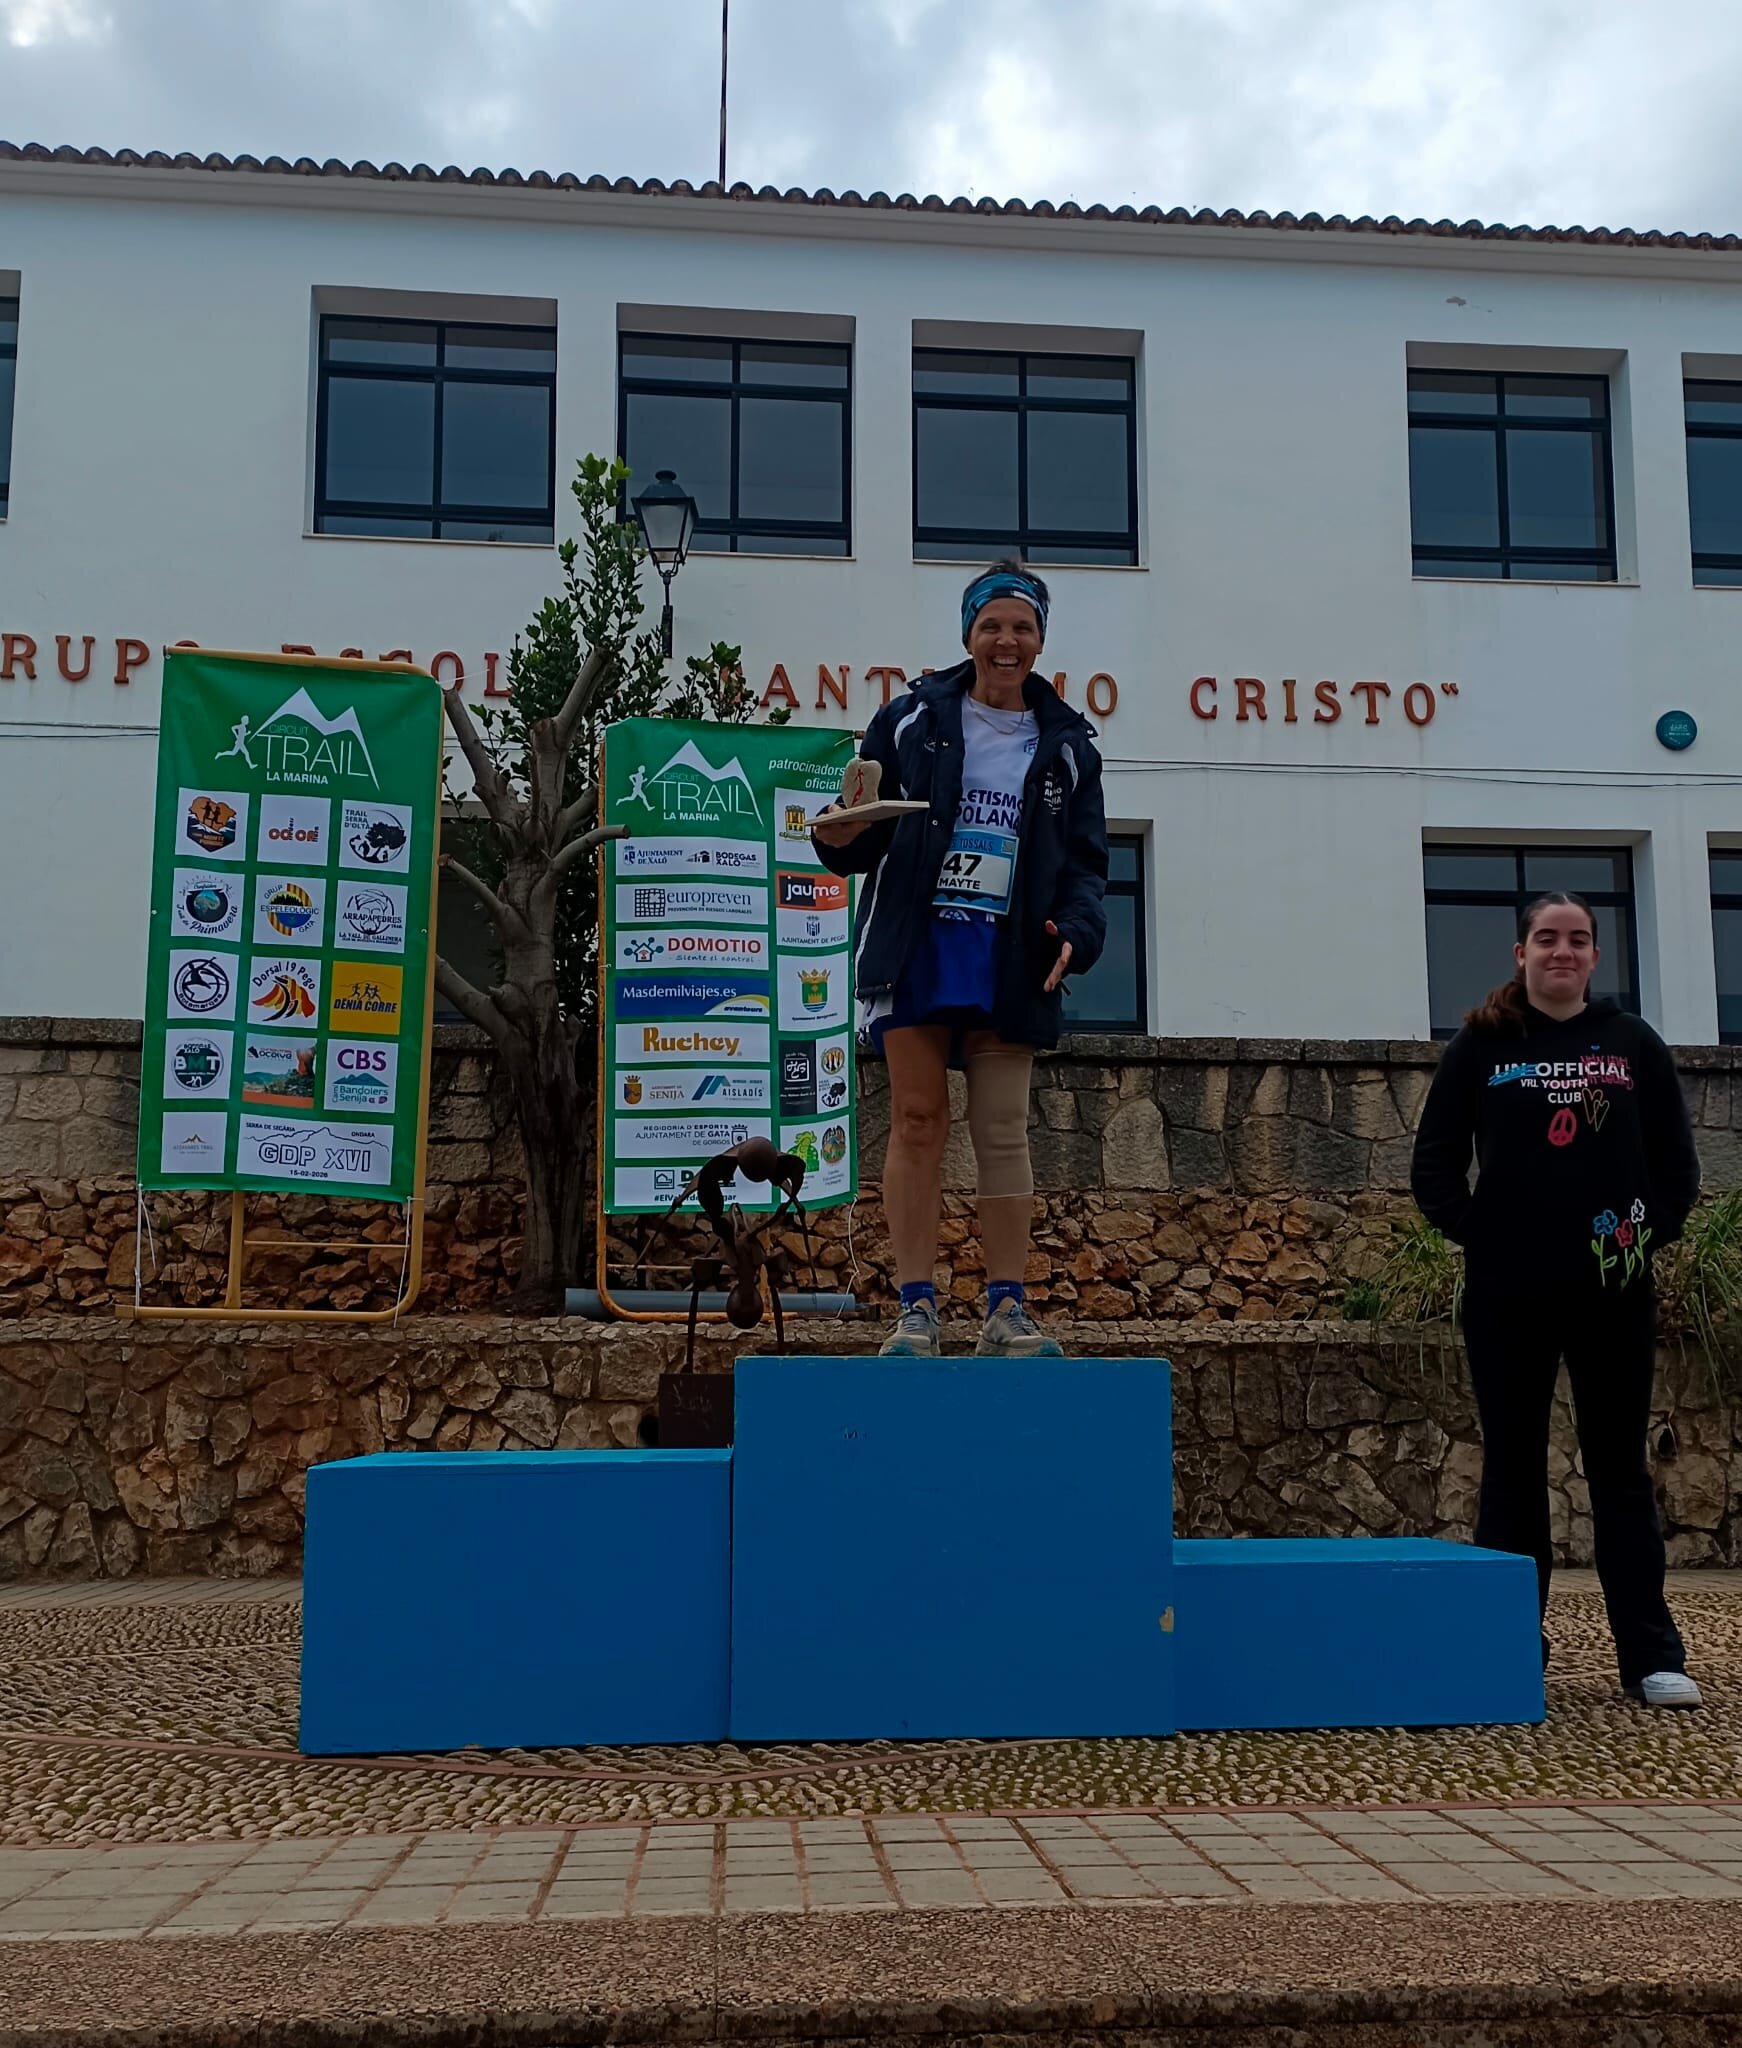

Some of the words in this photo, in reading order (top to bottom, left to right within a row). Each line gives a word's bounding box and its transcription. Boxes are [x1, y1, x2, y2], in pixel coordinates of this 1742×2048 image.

[268, 723, 309, 735] CIRCUIT
[257, 733, 369, 777] TRAIL
[768, 758, 846, 777] patrocinadors
[266, 771, 280, 782] LA
[283, 772, 328, 785] MARINA
[663, 772, 699, 782] CIRCUIT
[805, 777, 842, 791] oficial
[653, 780, 754, 815] TRAIL
[959, 789, 1023, 811] ETISM
[345, 809, 368, 817] TRAIL
[663, 811, 676, 820] LA
[680, 812, 720, 822] MARINA
[960, 838, 993, 852] TOSSALS
[715, 852, 757, 862] BODEGAS
[943, 852, 982, 877] 47
[785, 875, 840, 901] jaume
[939, 877, 981, 890] MAYTE
[666, 890, 752, 907] europreven
[668, 937, 761, 954] DOMOTIO
[252, 961, 282, 987] Dorsal
[286, 961, 297, 972] 19
[297, 966, 316, 990] Pego
[622, 985, 738, 1000] Masdemilviajes.es
[643, 1027, 740, 1056] Ruchey
[175, 1055, 221, 1070] BMT
[337, 1048, 387, 1072] CBS
[340, 1085, 389, 1096] Bandolers
[1541, 1078, 1588, 1090] YOUTH
[339, 1093, 368, 1105] Senija
[649, 1091, 685, 1100] SENIJA
[1547, 1091, 1583, 1104] CLUB
[635, 1130, 691, 1140] AJUNTAMENT
[693, 1130, 706, 1139] DE
[707, 1130, 731, 1138] GATA
[692, 1139, 702, 1147] DE
[702, 1138, 731, 1147] GORGOS
[258, 1142, 316, 1167] GDP
[322, 1148, 371, 1172] XVI
